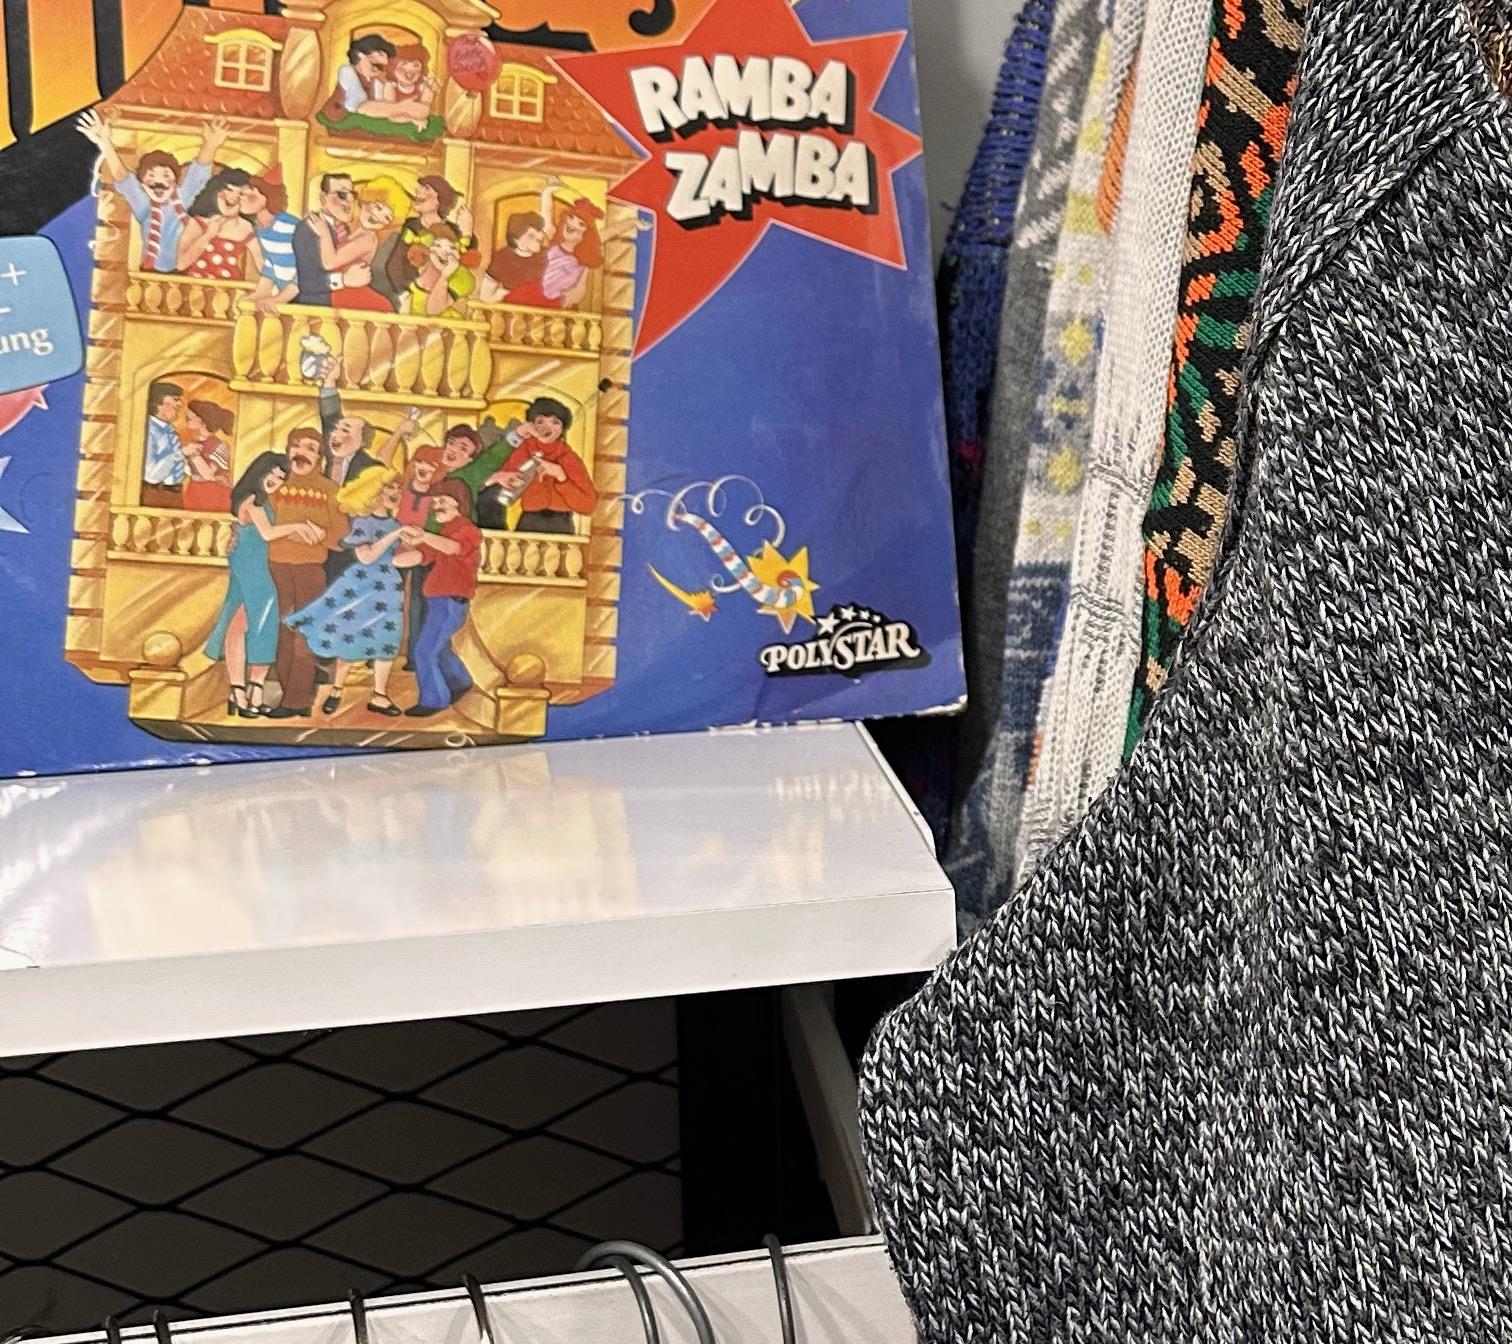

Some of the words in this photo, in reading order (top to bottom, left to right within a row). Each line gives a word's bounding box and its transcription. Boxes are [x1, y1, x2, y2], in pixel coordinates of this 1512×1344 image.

[630, 52, 852, 136] RAMBA
[664, 129, 874, 223] ZAMBA
[759, 620, 921, 673] POLYSTAR
